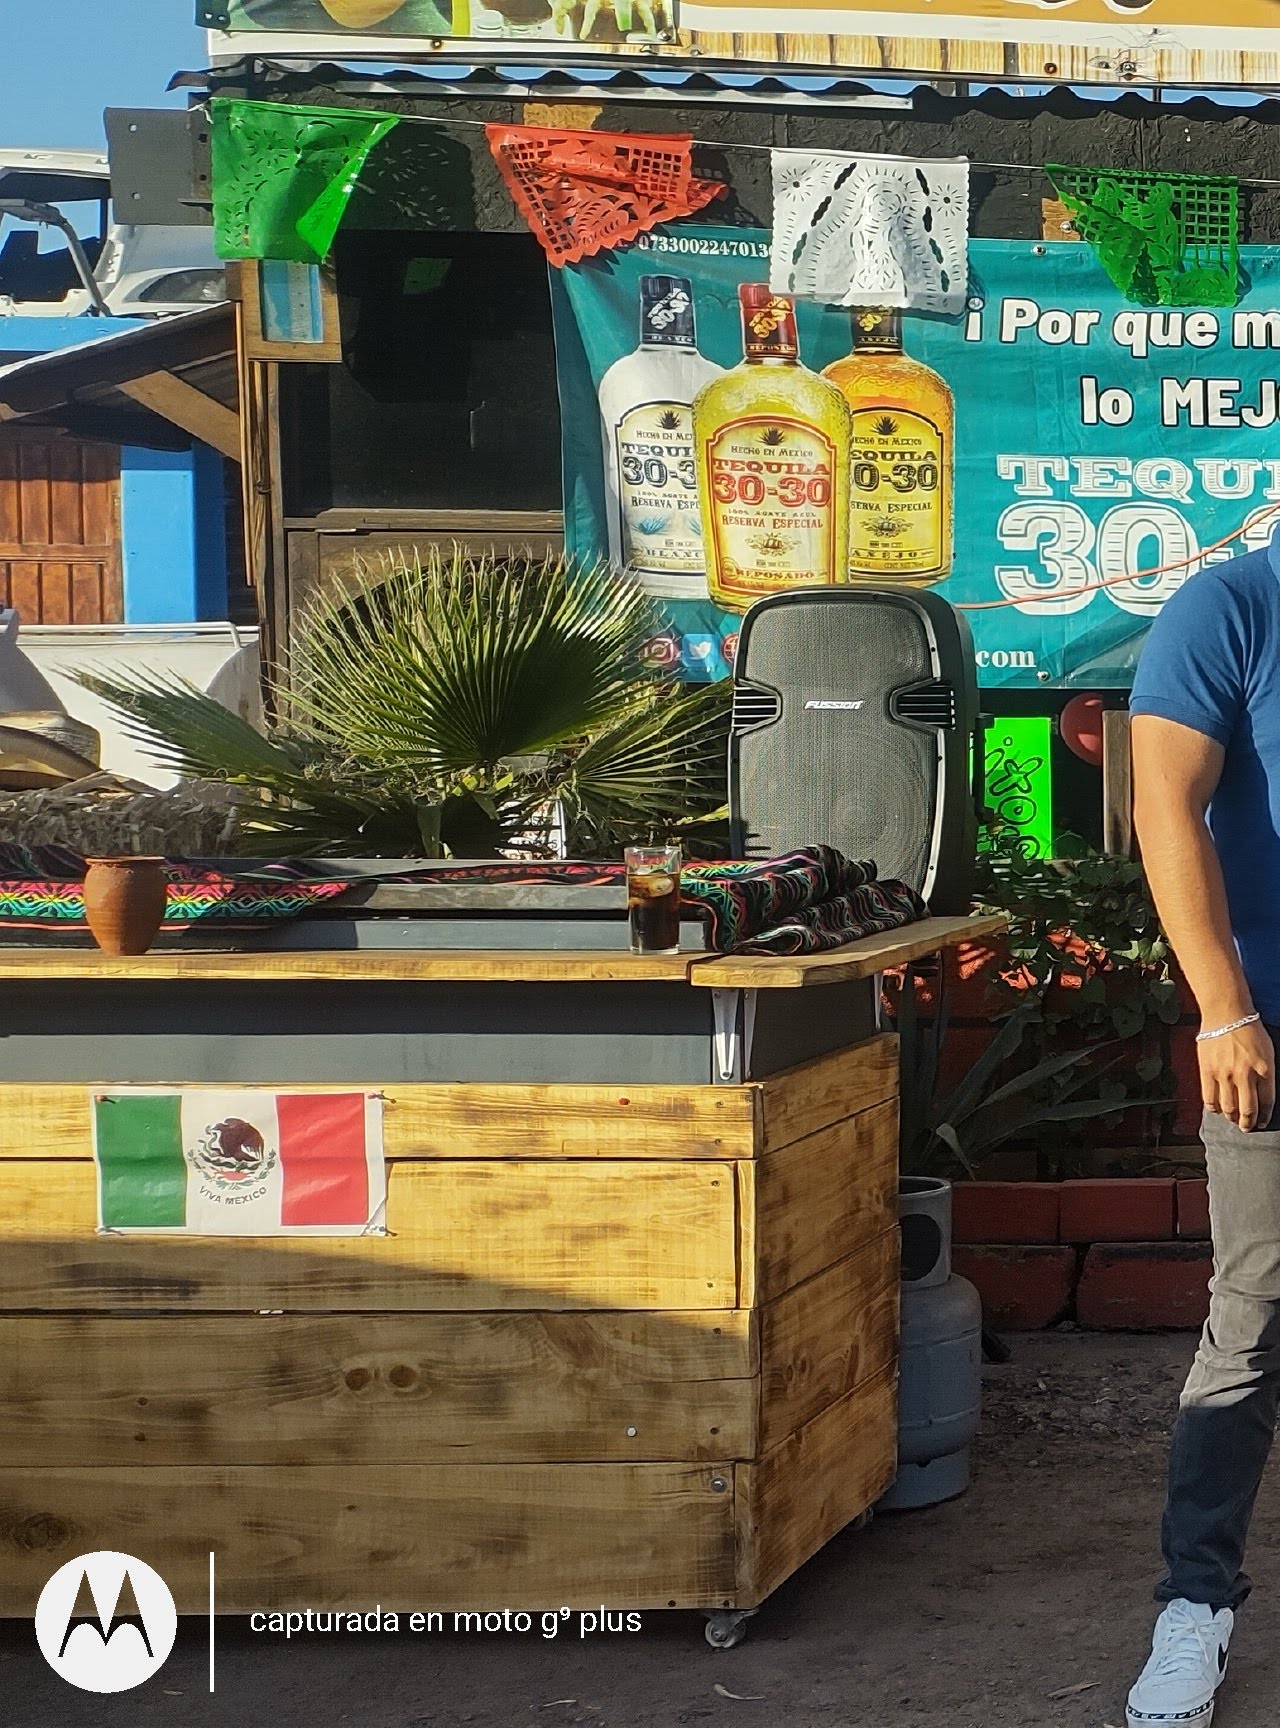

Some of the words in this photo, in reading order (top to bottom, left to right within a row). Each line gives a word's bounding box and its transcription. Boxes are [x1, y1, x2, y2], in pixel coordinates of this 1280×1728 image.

[1000, 299, 1100, 345] Por
[1112, 311, 1218, 358] que
[1080, 376, 1134, 427] lo
[622, 442, 693, 457] TEQUI
[851, 450, 937, 462] EQUILA
[623, 456, 697, 489] 30-3
[714, 458, 830, 476] TEQUILA
[852, 462, 938, 493] 0-30
[713, 472, 831, 508] 30-30
[851, 500, 881, 512] SERVA
[888, 501, 932, 514] ESPECIAL
[722, 514, 765, 528] RESERVA
[773, 518, 823, 530] ESPECIAL
[200, 1186, 221, 1203] VIVA
[225, 1187, 266, 1204] MEXICO
